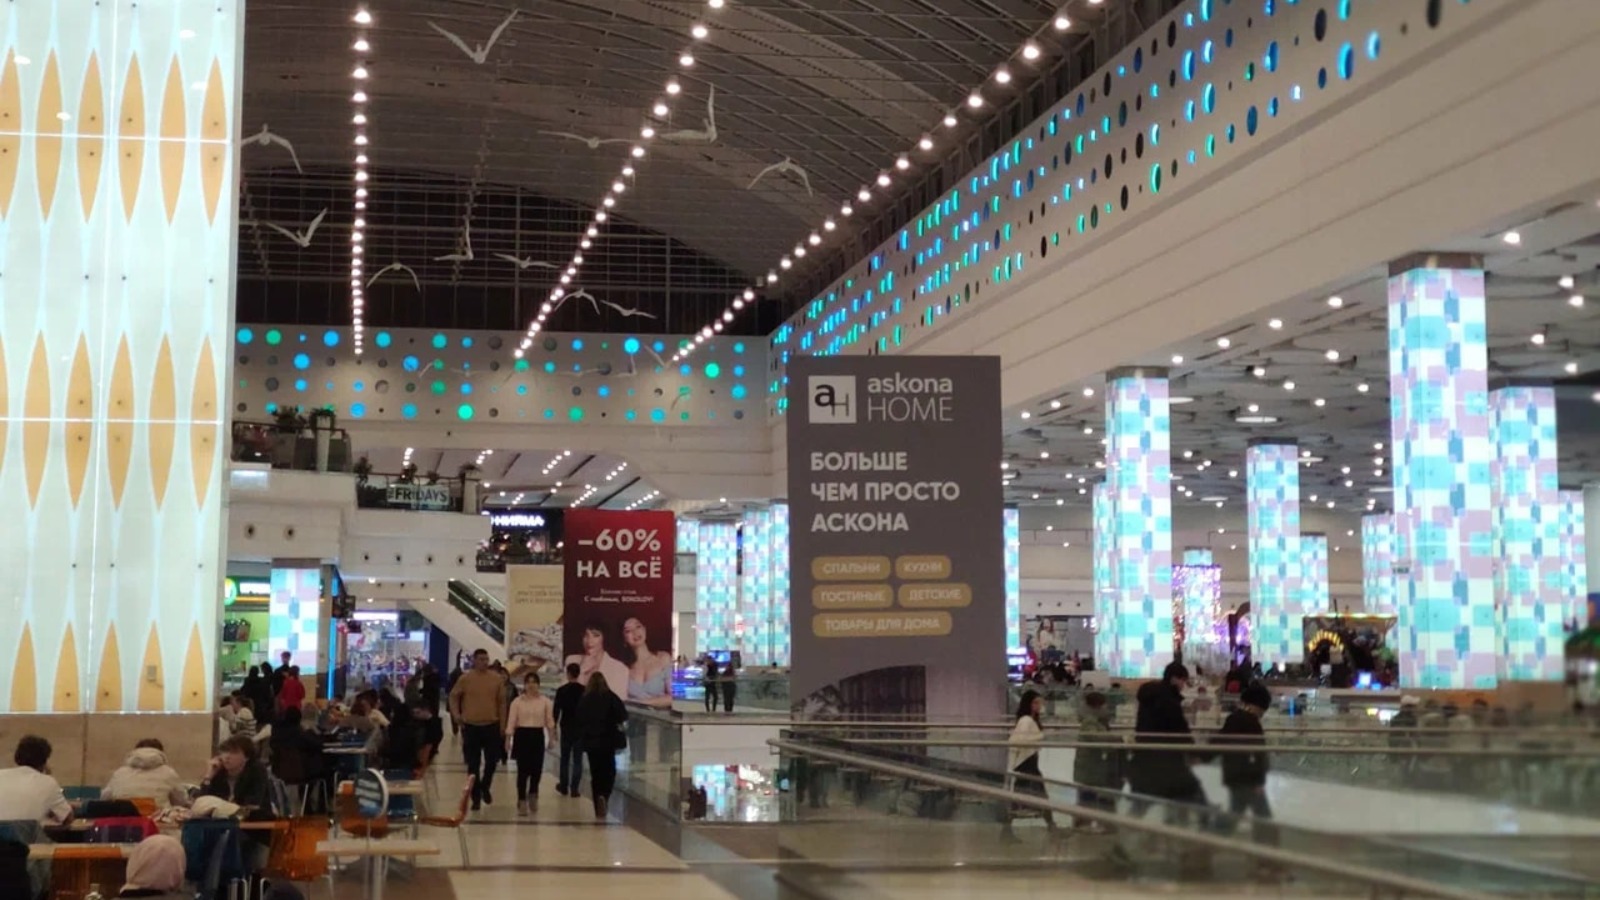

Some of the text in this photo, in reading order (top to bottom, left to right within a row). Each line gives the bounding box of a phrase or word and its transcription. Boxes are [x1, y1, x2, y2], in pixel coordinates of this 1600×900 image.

[867, 372, 953, 393] askona
[868, 397, 954, 421] HOME
[811, 452, 907, 471] БОЛЬШЕ
[395, 487, 448, 503] FRIDAYS
[811, 482, 960, 501] ЧЕМ ПРОСТО
[811, 512, 909, 532] АСКОНА
[578, 528, 661, 551] -60%
[577, 556, 662, 578] НА ВСЁ
[823, 562, 881, 574] СПАЛЬНИ
[904, 562, 942, 573] КУХНИ
[821, 590, 885, 603] ГОСТИНЫЕ
[909, 588, 961, 601] ДЕТСКИЕ
[825, 617, 940, 632] ТОВАРЫ ДЛЯ ДОМА
